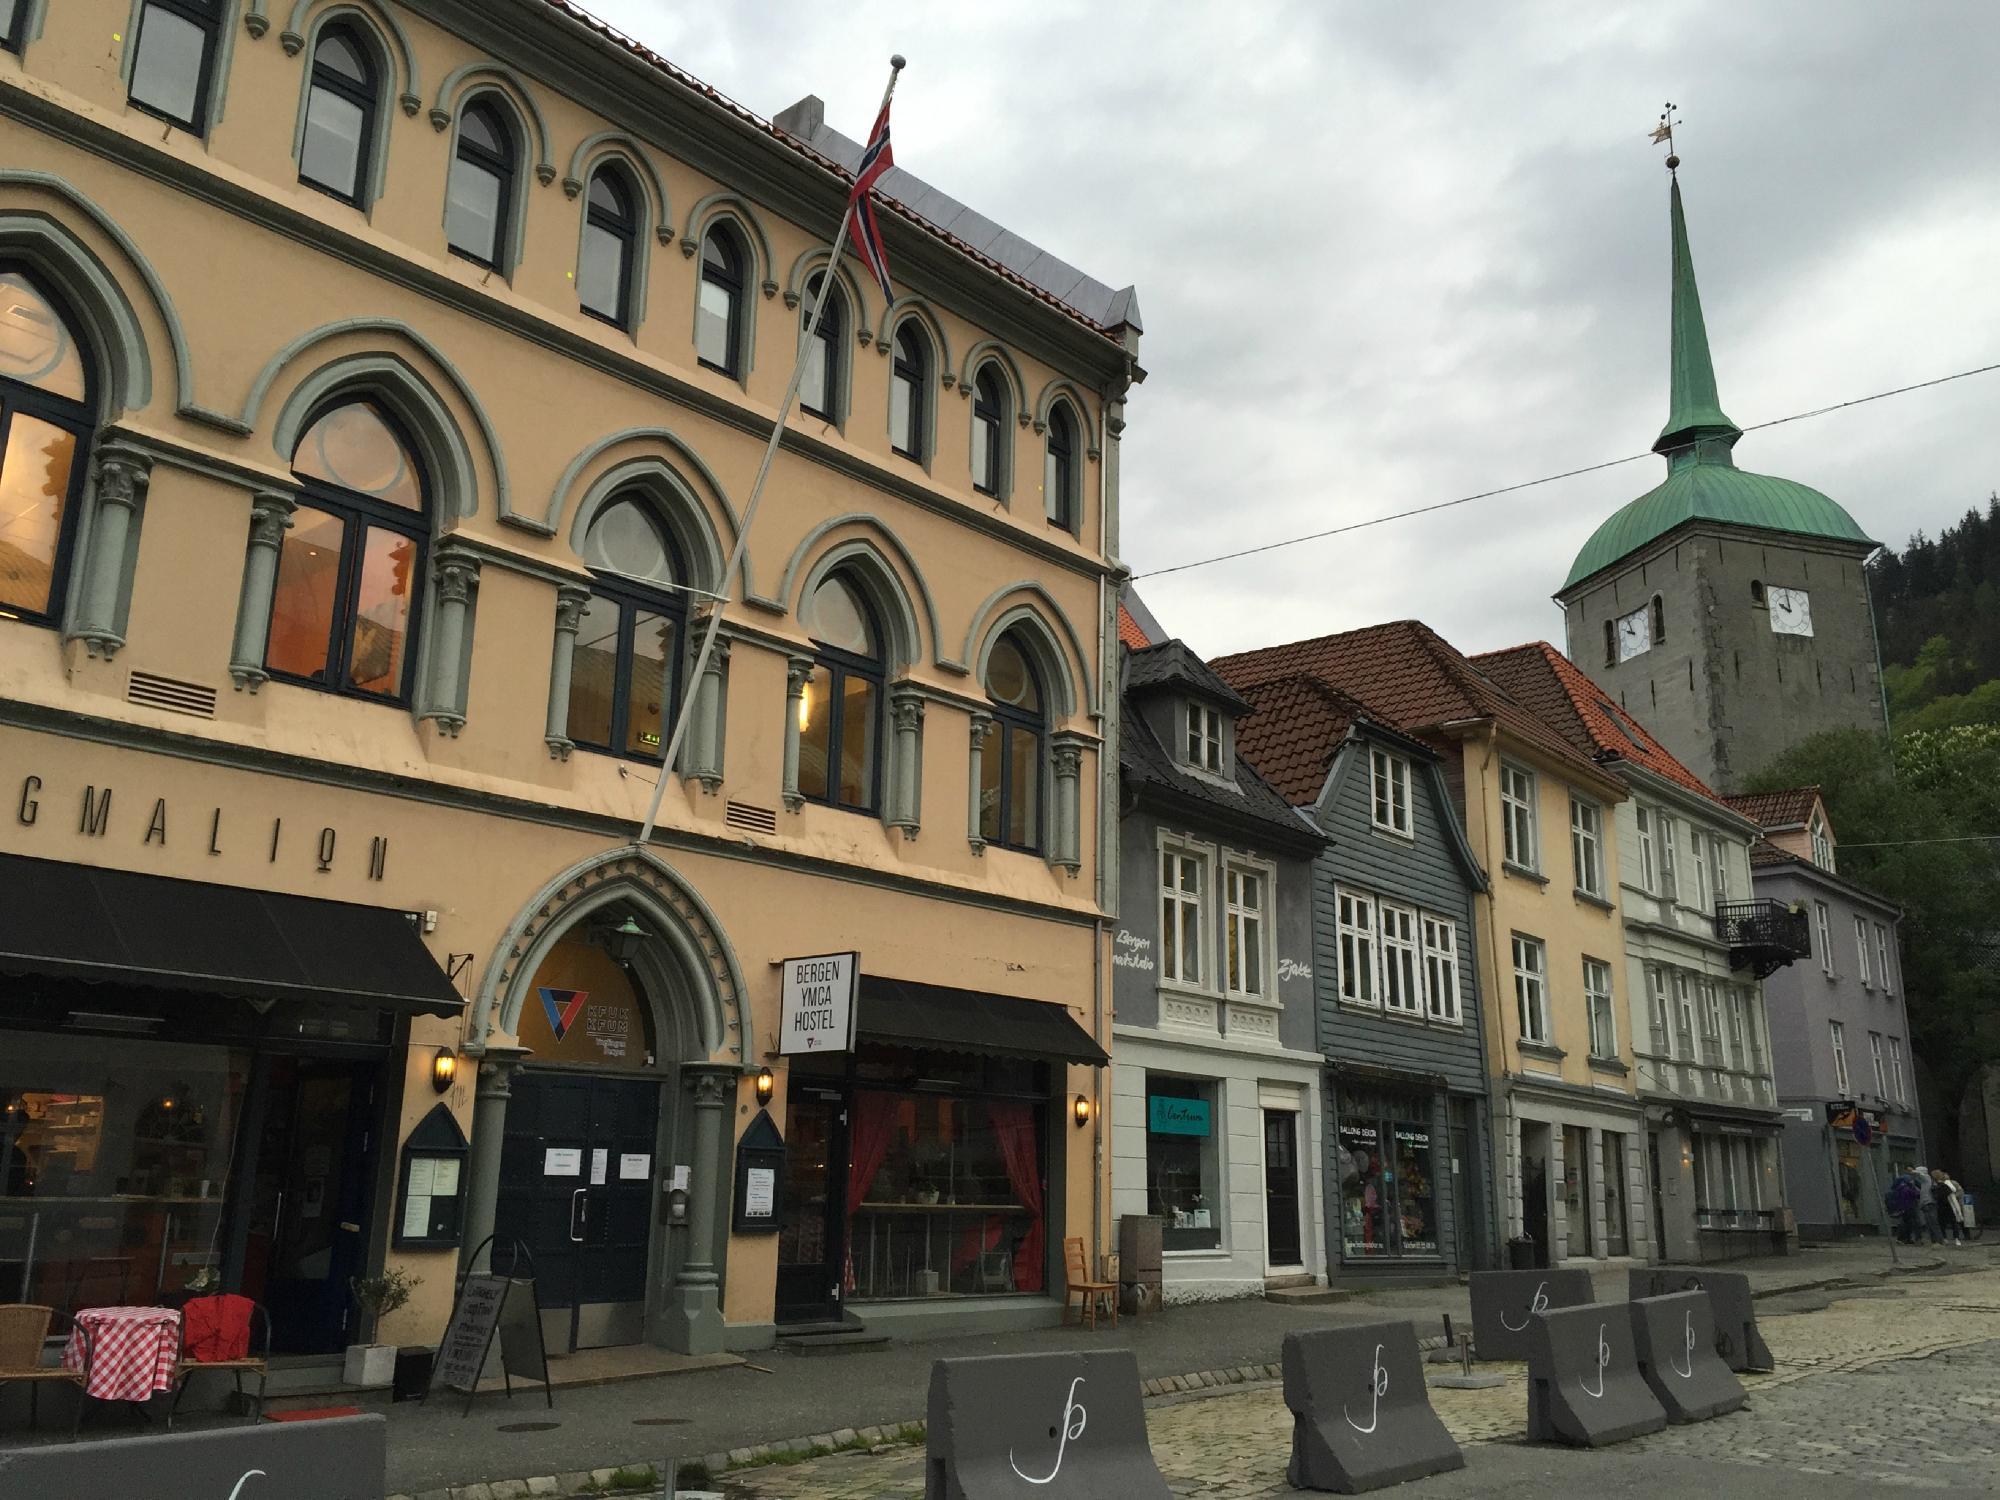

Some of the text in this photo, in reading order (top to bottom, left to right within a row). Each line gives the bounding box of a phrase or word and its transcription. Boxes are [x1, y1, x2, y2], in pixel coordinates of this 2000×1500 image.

[1116, 929, 1151, 952] Bergen
[796, 960, 840, 984] BERGEN
[801, 985, 832, 1007] YMCA
[587, 1005, 629, 1020] KFUK
[794, 1009, 835, 1032] HOSTEL
[586, 1018, 628, 1033] KFUM
